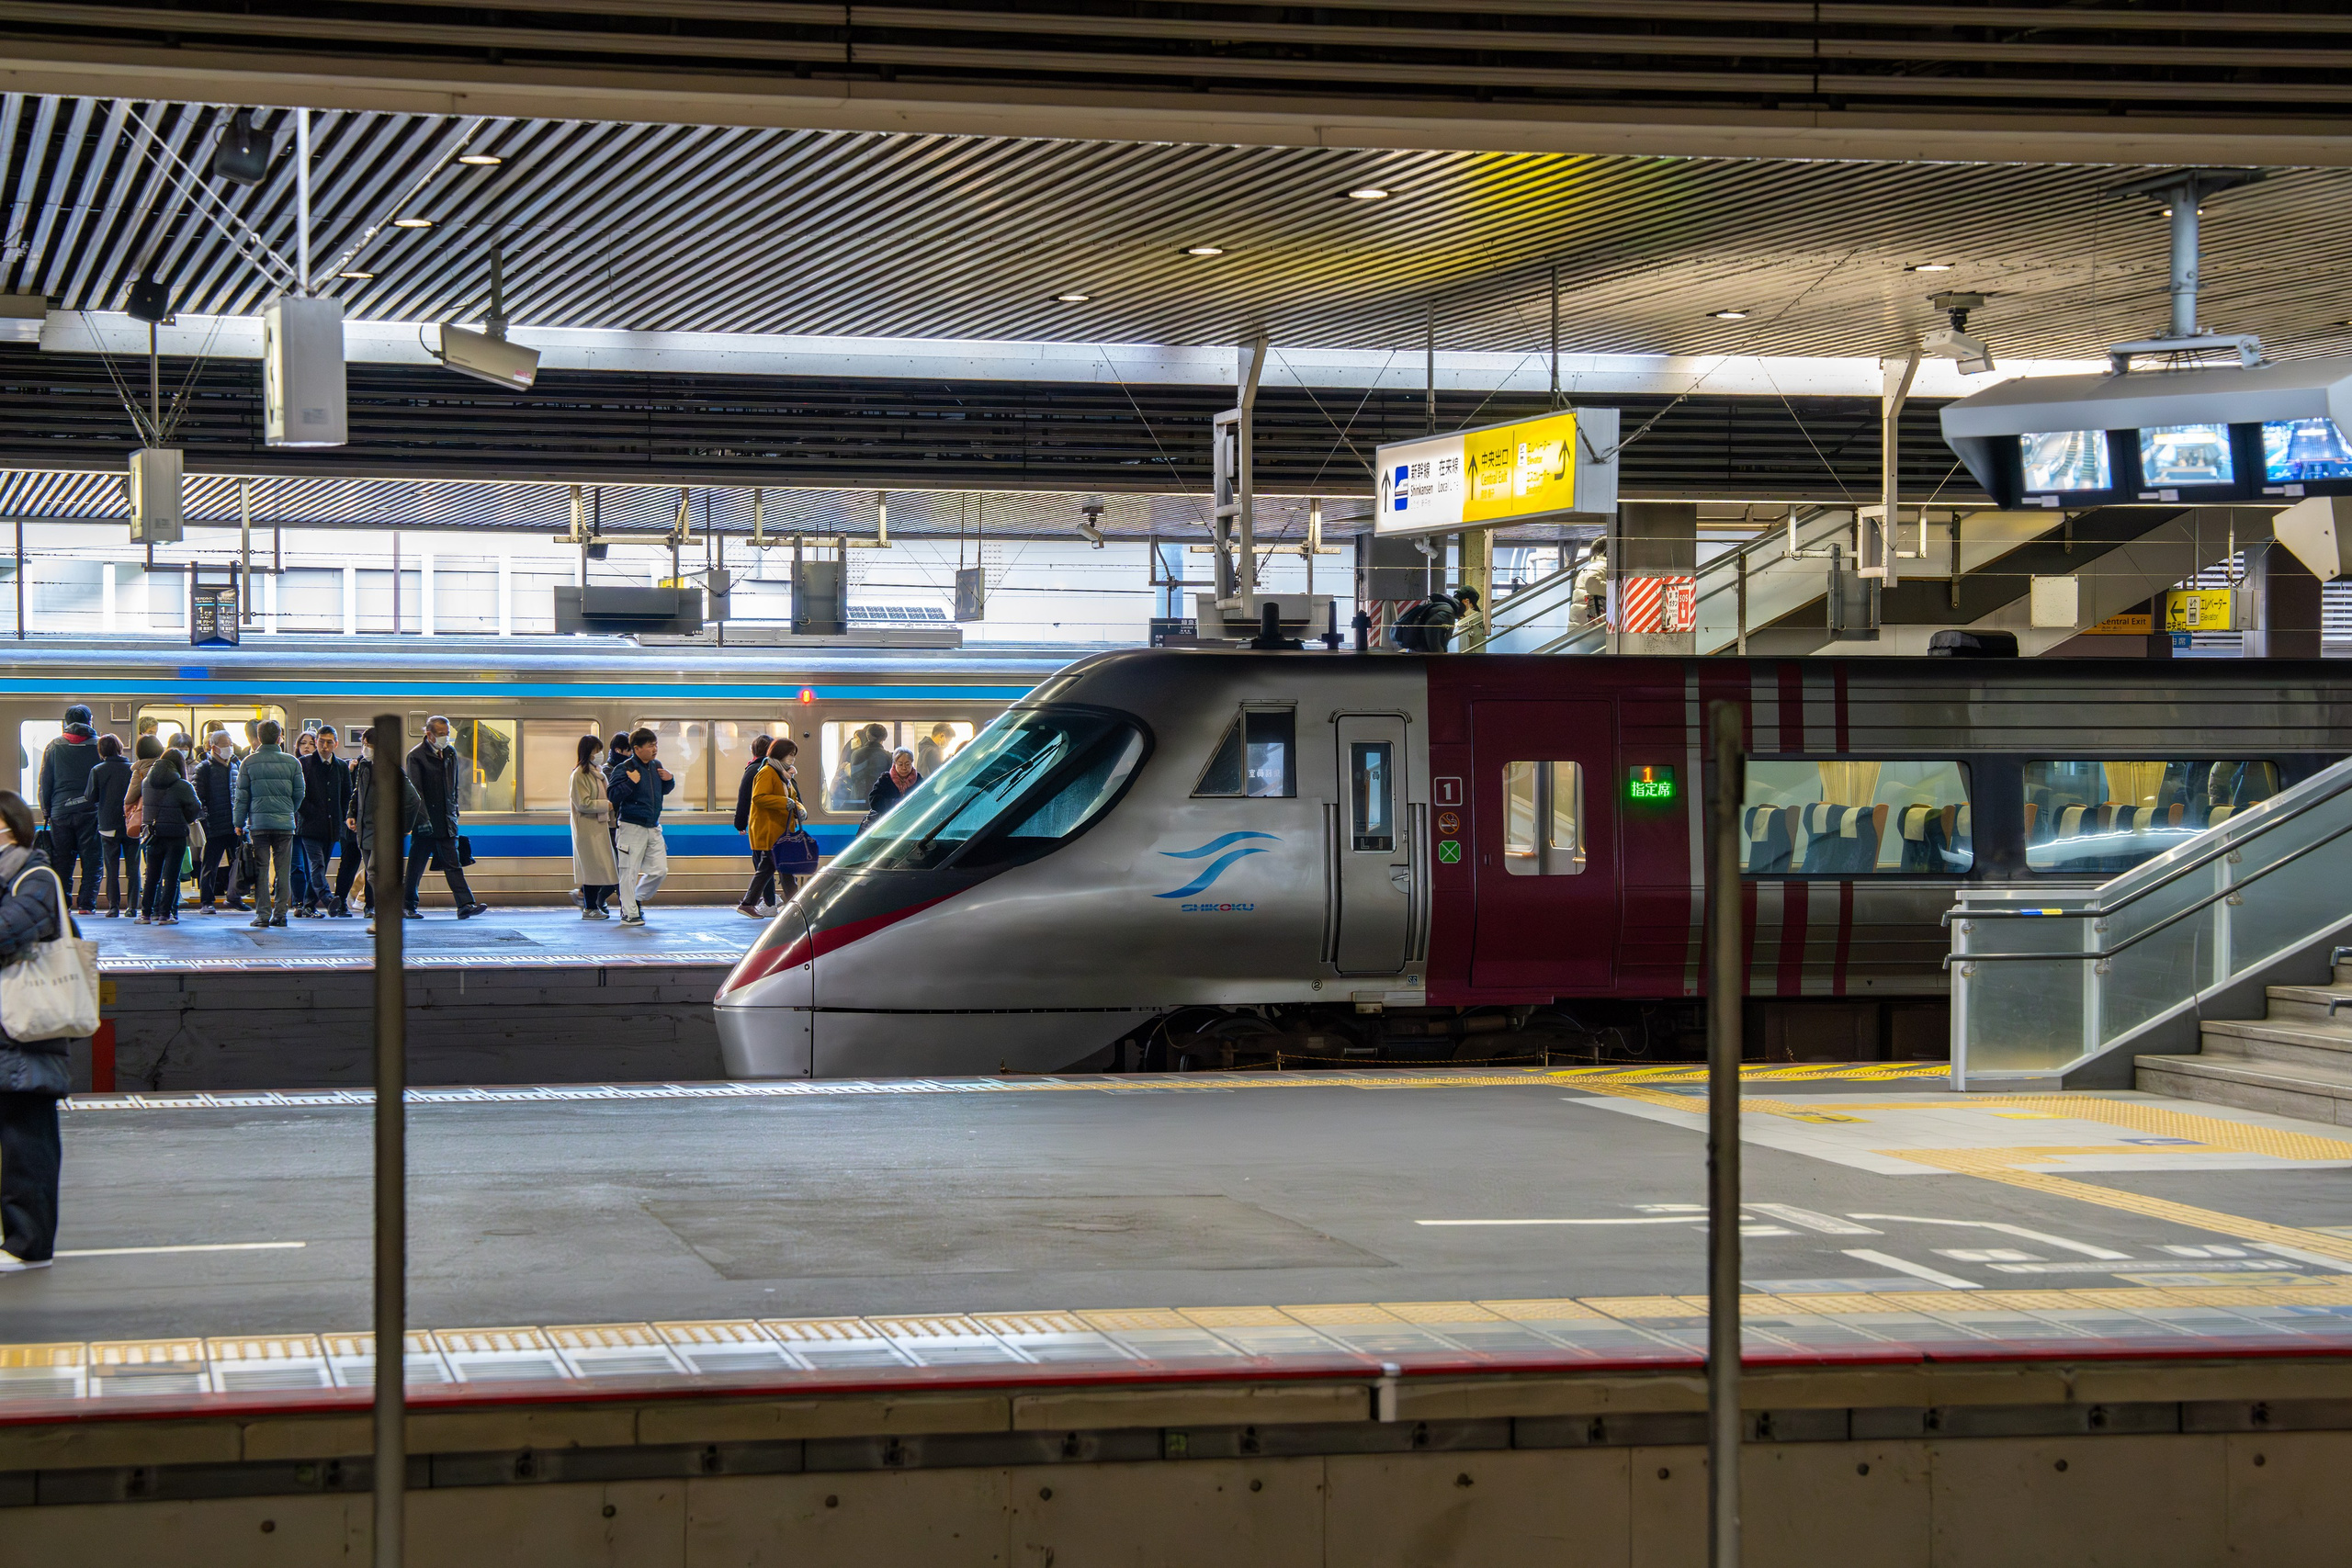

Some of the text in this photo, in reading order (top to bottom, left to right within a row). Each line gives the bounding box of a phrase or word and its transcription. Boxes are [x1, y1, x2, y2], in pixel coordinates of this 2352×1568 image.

[1481, 448, 1508, 468] 中央出口
[1410, 457, 1458, 480] 新幹線 在来線
[1481, 469, 1508, 486] Central Exit
[1410, 482, 1433, 497] Shinkansen
[1679, 593, 1689, 603] SOS
[2199, 598, 2227, 610] エレベーター
[1643, 767, 1652, 782] 1
[1443, 783, 1452, 800] 1
[1631, 781, 1671, 797] 指定席
[1181, 903, 1255, 912] SHIKOKU
